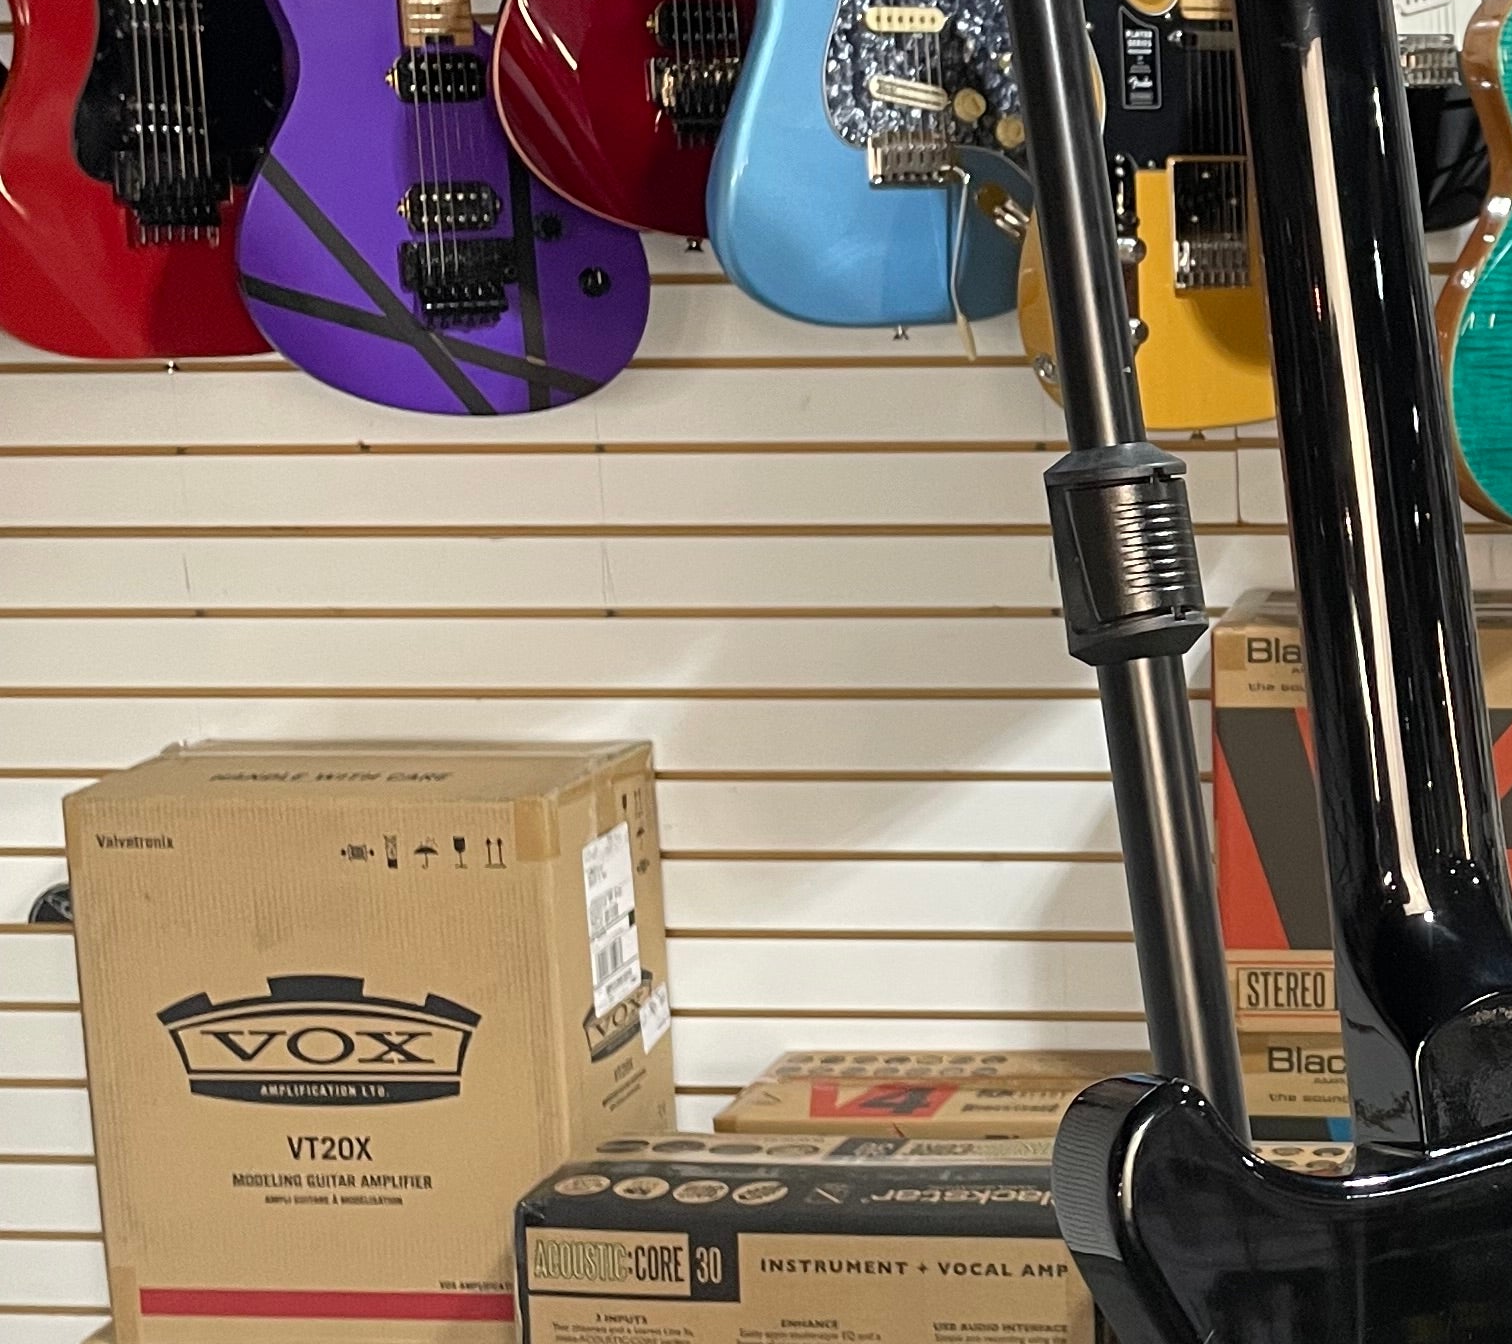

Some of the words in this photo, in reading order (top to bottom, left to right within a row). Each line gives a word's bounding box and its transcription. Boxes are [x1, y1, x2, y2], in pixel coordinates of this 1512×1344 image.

[96, 833, 174, 850] Valvetronix
[1247, 971, 1326, 1008] STEREO
[200, 1027, 435, 1066] VOX
[260, 1084, 356, 1098] AMPLIFICATION
[287, 1135, 373, 1161] VT20X
[232, 1173, 302, 1188] MODELING
[306, 1174, 356, 1188] GUITAR
[360, 1175, 432, 1190] AMPLIFIER
[871, 1189, 1055, 1205] lackstar
[696, 1247, 723, 1284] 30
[761, 1258, 908, 1275] INSTRUMENT
[938, 1262, 1012, 1277] VOCAL
[1021, 1263, 1068, 1277] AMP
[604, 1314, 648, 1325] INPUTS
[960, 1323, 999, 1332] AUDIO
[1002, 1323, 1069, 1333] INTERFACE
